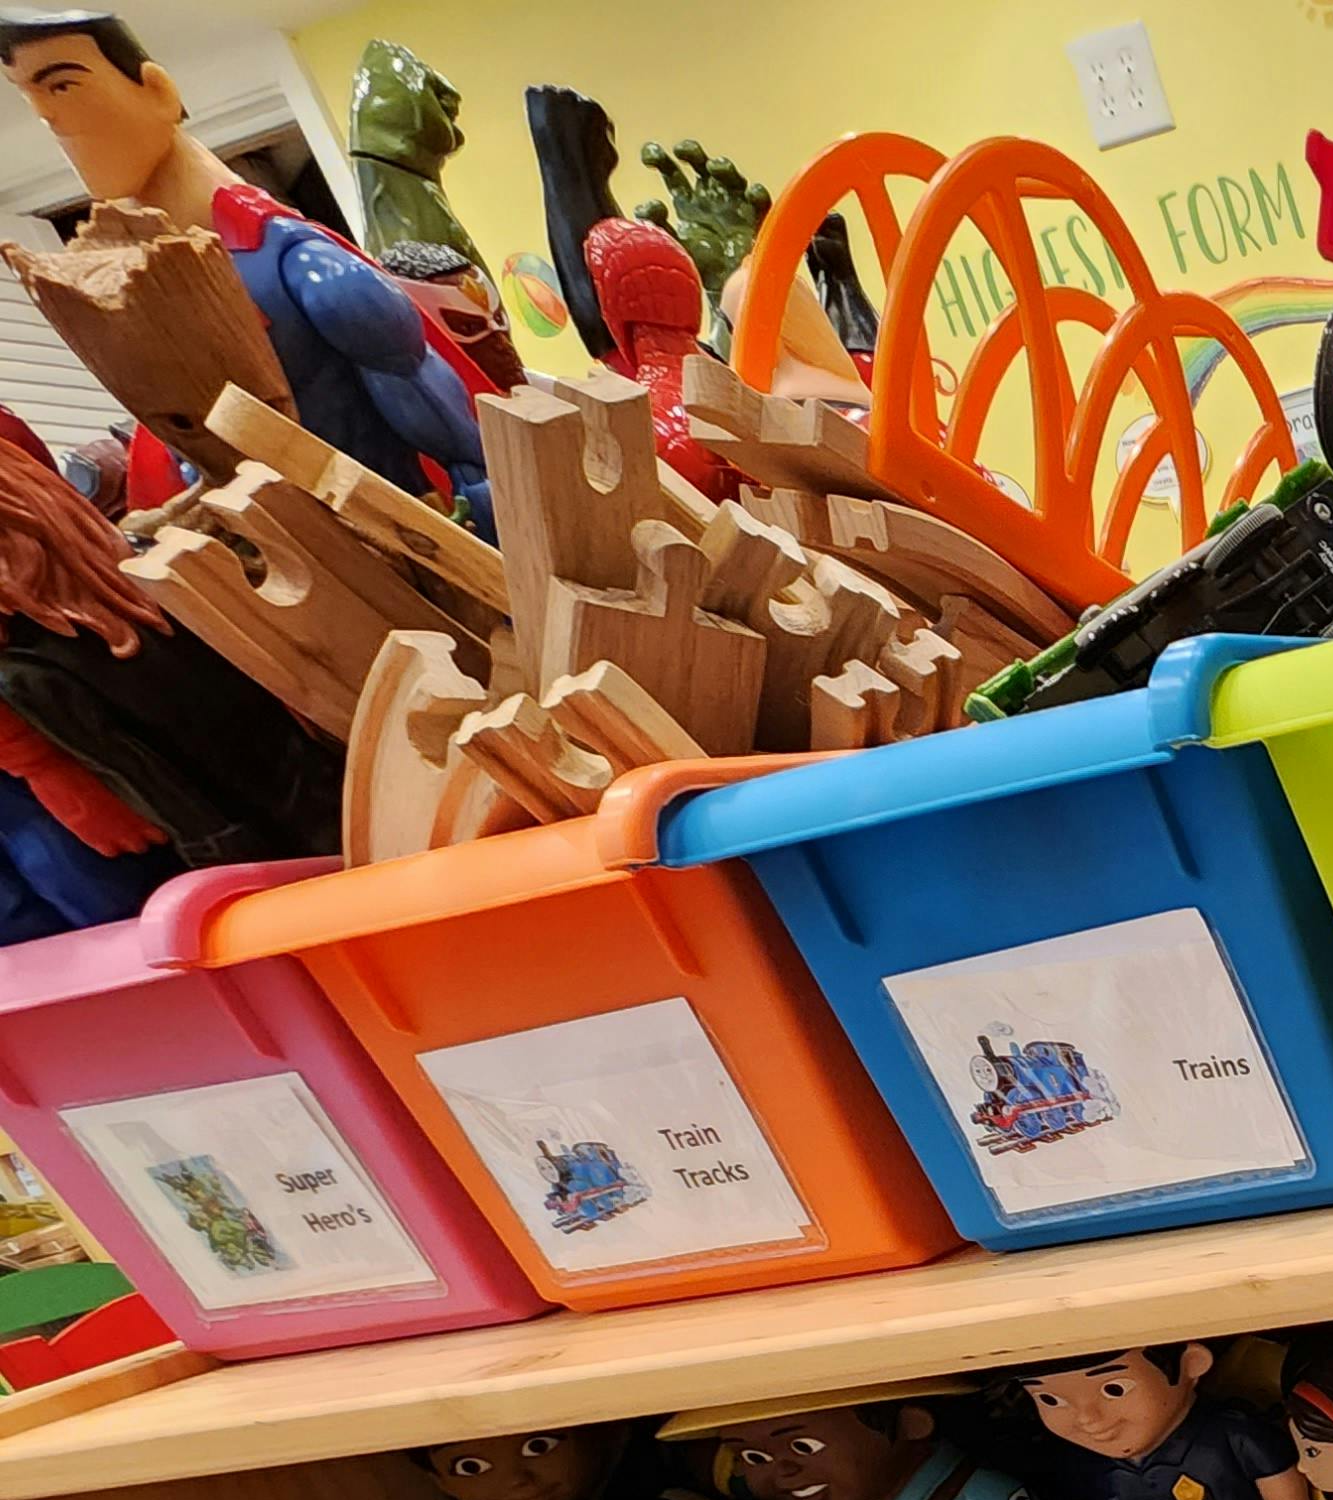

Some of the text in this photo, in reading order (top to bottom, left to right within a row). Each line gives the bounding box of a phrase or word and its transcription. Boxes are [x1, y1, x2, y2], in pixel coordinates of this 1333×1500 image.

[1158, 161, 1306, 274] FORM
[1173, 1055, 1251, 1081] Trains
[659, 1123, 722, 1151] Train
[276, 1165, 338, 1194] Super
[675, 1159, 750, 1190] Tracks
[302, 1204, 372, 1233] Hero's
